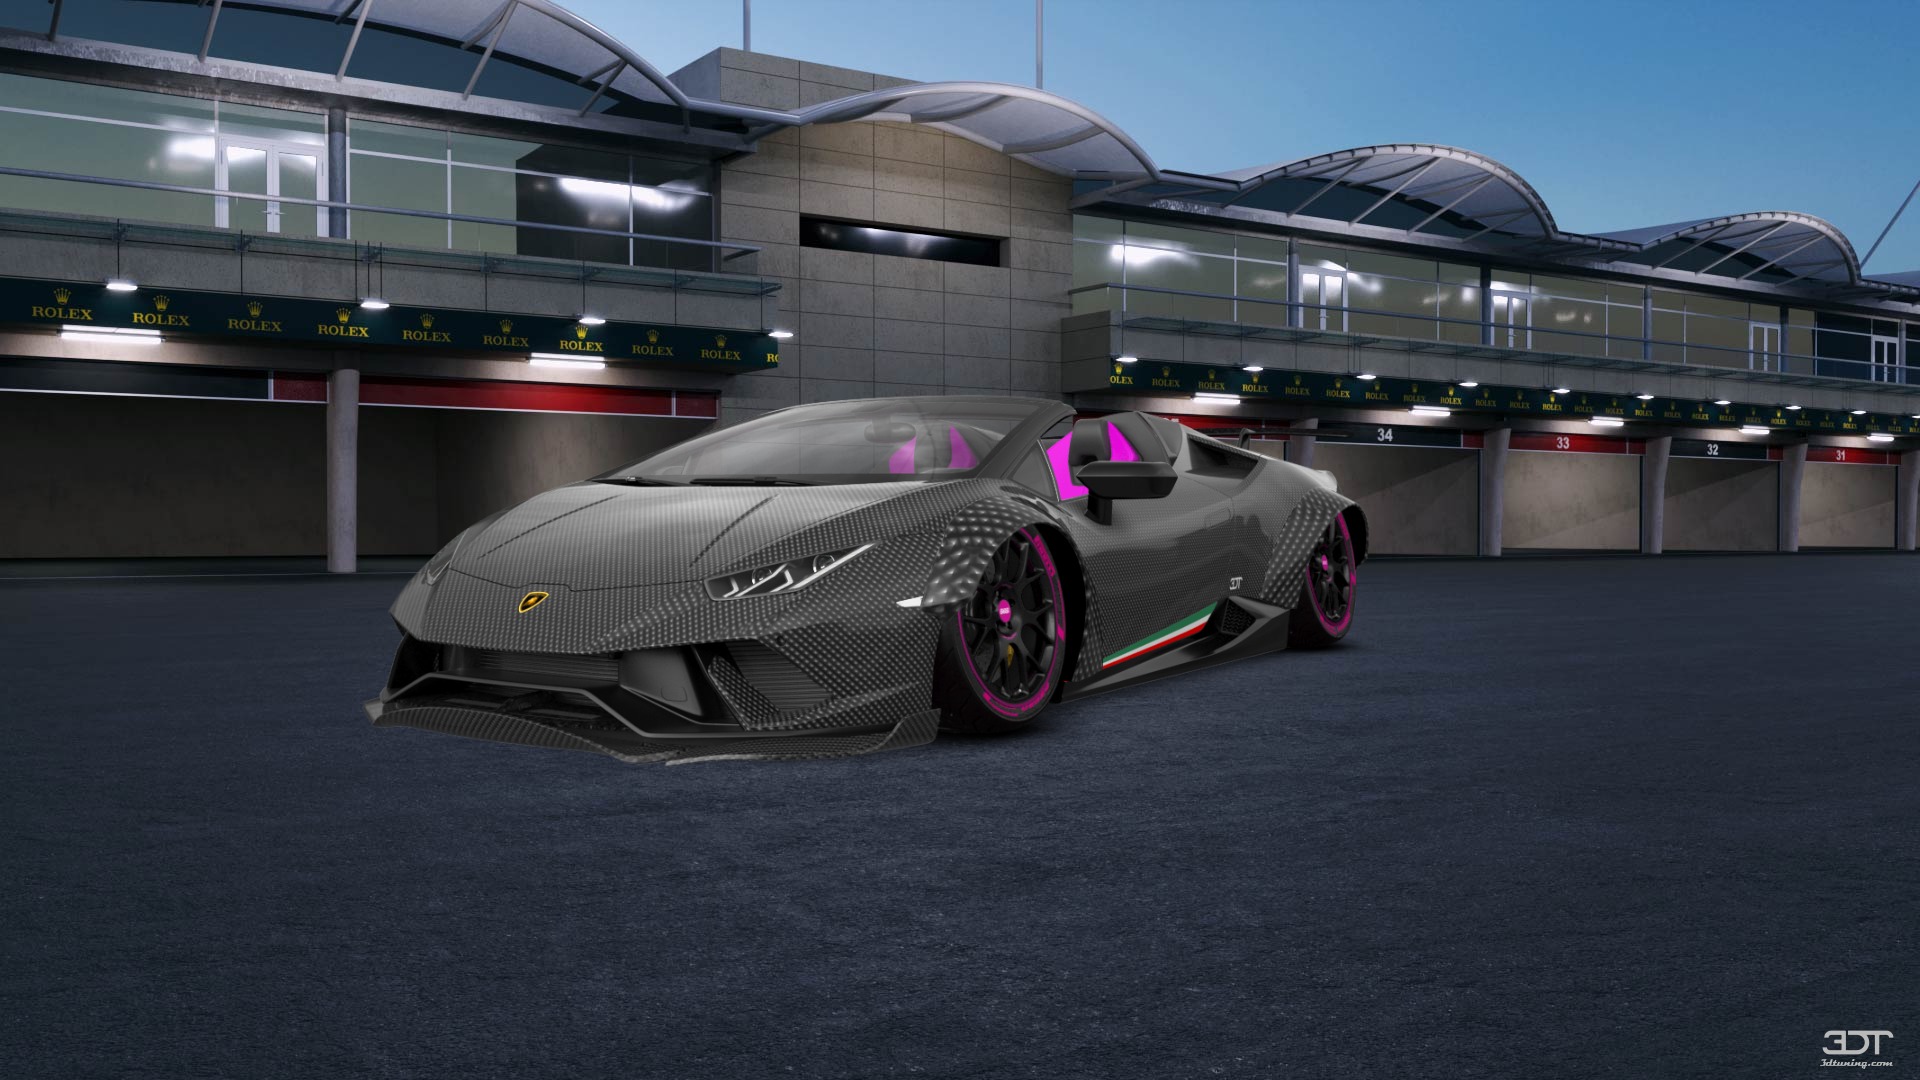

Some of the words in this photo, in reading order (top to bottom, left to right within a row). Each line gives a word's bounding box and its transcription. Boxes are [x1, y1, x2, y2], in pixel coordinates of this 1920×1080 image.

[32, 306, 93, 320] ROLEX
[132, 312, 190, 326] ROLEX
[228, 319, 282, 332] ROLEX
[318, 324, 369, 338] ROLEX
[403, 330, 452, 342] ROLEX
[483, 335, 529, 347] ROLEX
[560, 339, 604, 352] ROLEX
[632, 344, 674, 356] ROLEX
[701, 349, 741, 360] ROLEX
[1109, 375, 1134, 385] OLEX
[1152, 378, 1180, 387] ROLEX
[1198, 381, 1225, 390] ROLEX
[1242, 383, 1268, 392] ROLEX
[1285, 386, 1310, 395] ROLEX
[1326, 389, 1350, 398] ROLEX
[1365, 391, 1389, 400] ROLEX
[1404, 394, 1426, 403] ROLEX
[1440, 396, 1462, 405] ROLEX
[1475, 398, 1496, 407] ROLEX
[1509, 400, 1530, 409] ROLEX
[1542, 403, 1562, 411] ROLEX
[1605, 407, 1624, 415] ROLEX
[1377, 427, 1393, 442] 34
[1556, 436, 1570, 449] 33
[1707, 443, 1719, 456] 32
[1836, 449, 1846, 460] 31
